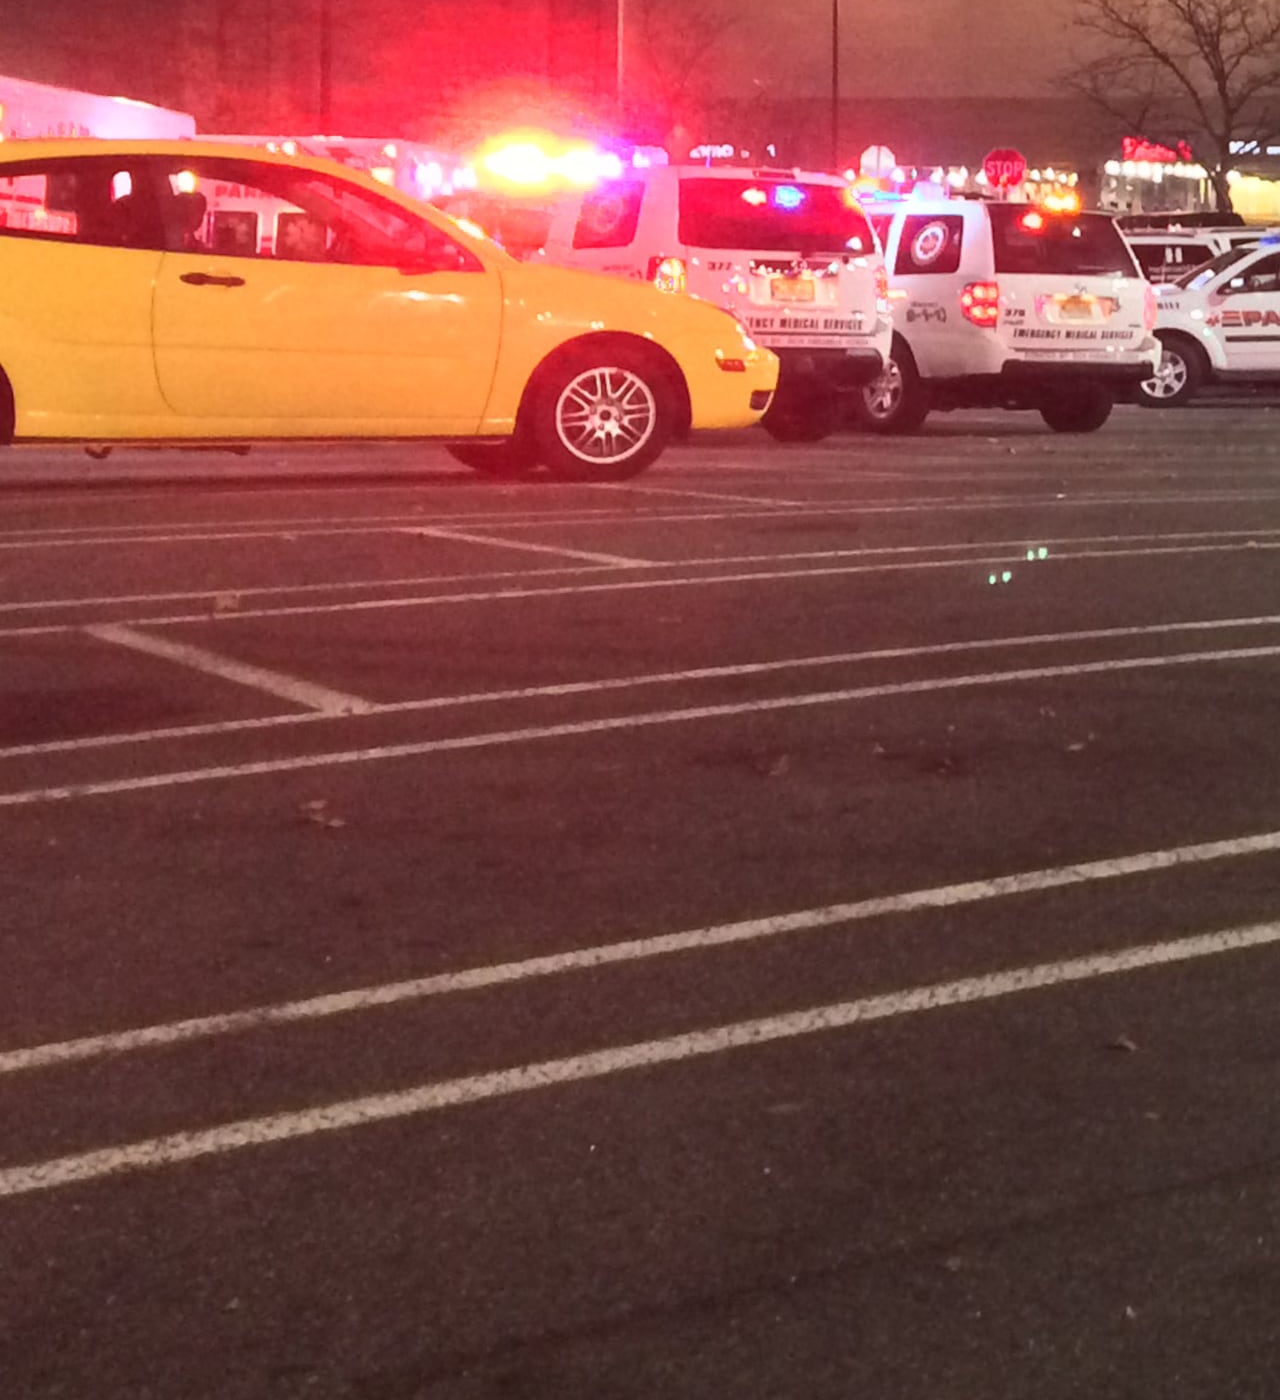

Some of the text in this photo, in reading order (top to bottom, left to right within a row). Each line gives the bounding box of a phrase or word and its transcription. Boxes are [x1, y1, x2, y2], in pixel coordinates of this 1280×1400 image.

[985, 160, 1023, 177] STOP
[780, 318, 819, 330] MEDICAL
[824, 319, 863, 331] SERVICES
[1013, 328, 1134, 341] EMERGENCY MEDICAL SERVICES
